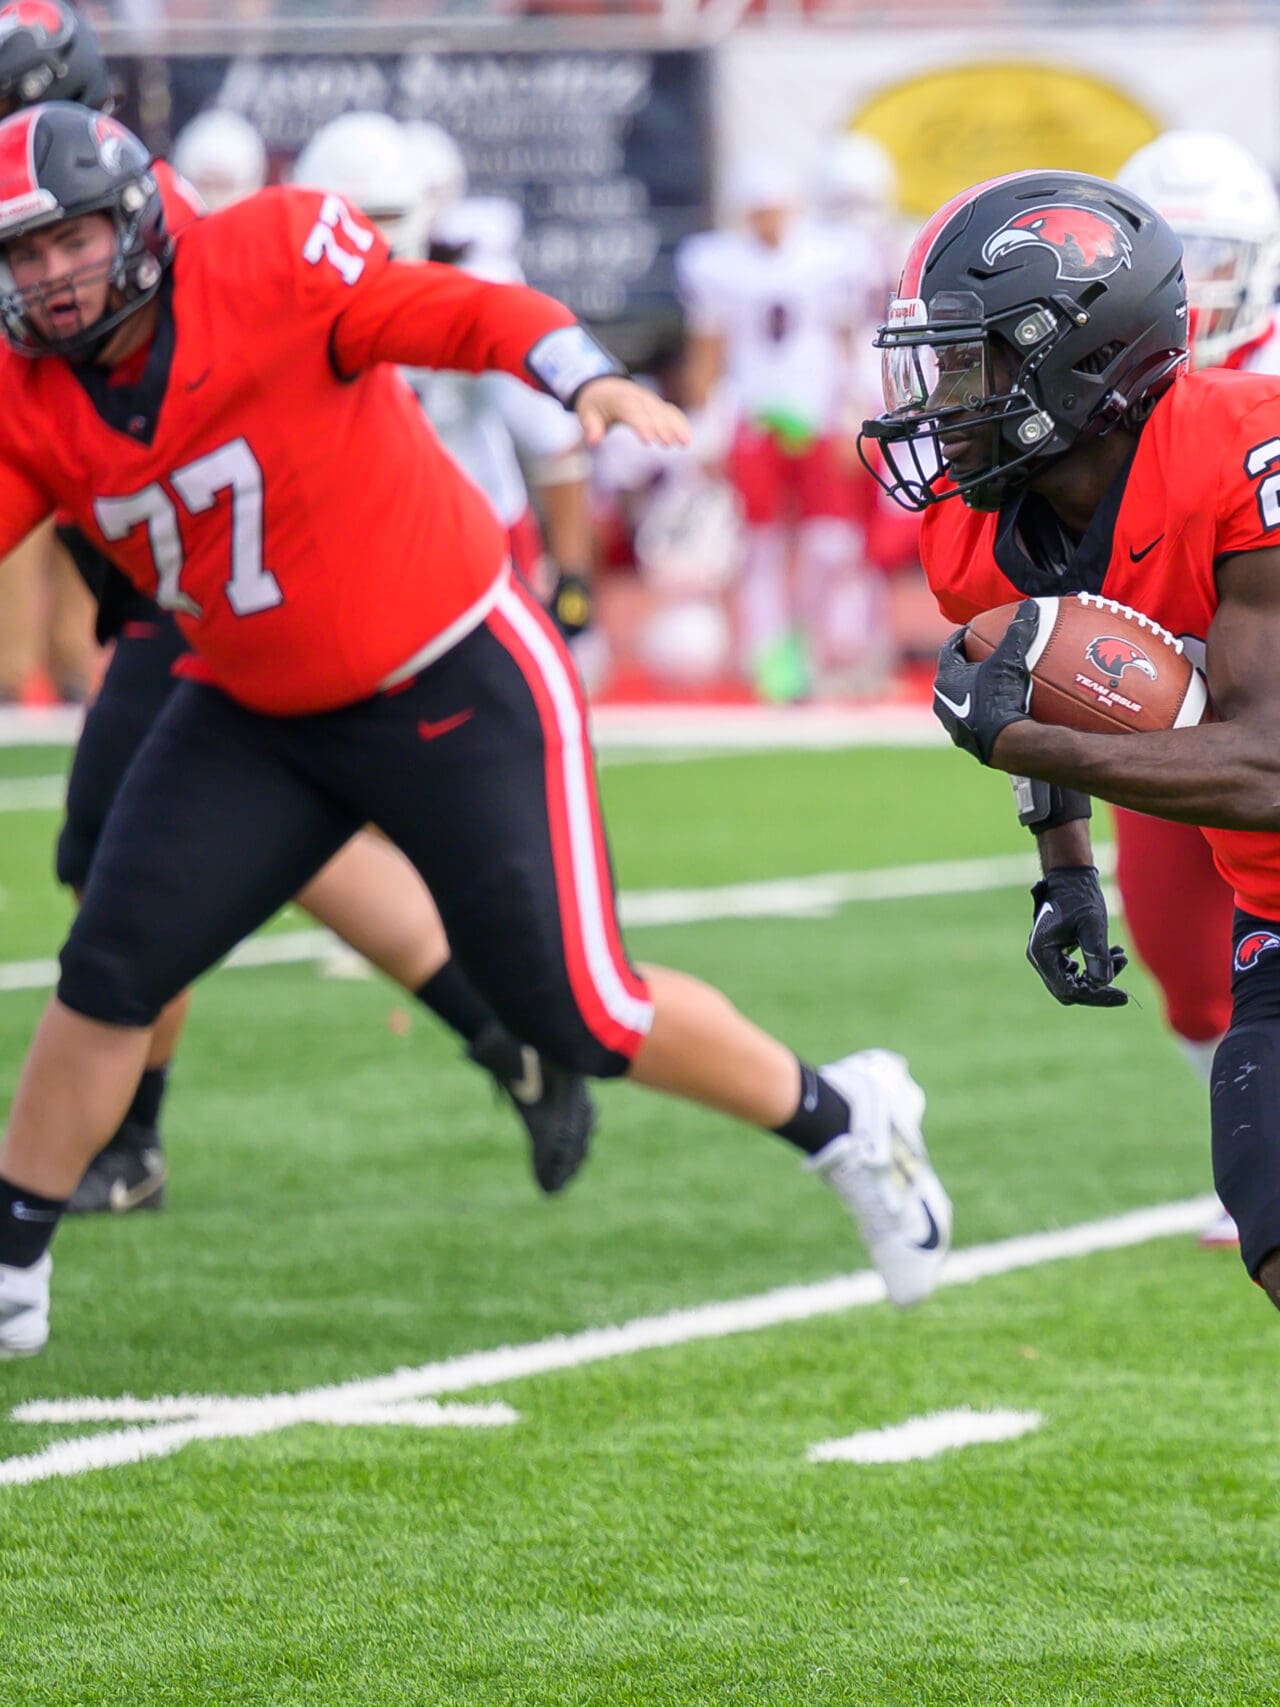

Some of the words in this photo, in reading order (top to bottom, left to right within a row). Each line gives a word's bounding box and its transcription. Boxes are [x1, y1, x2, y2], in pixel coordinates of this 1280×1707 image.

[303, 194, 375, 286] 77
[93, 437, 284, 617] 77
[1075, 673, 1109, 695] TEAM
[1110, 692, 1142, 712] ISSUE
